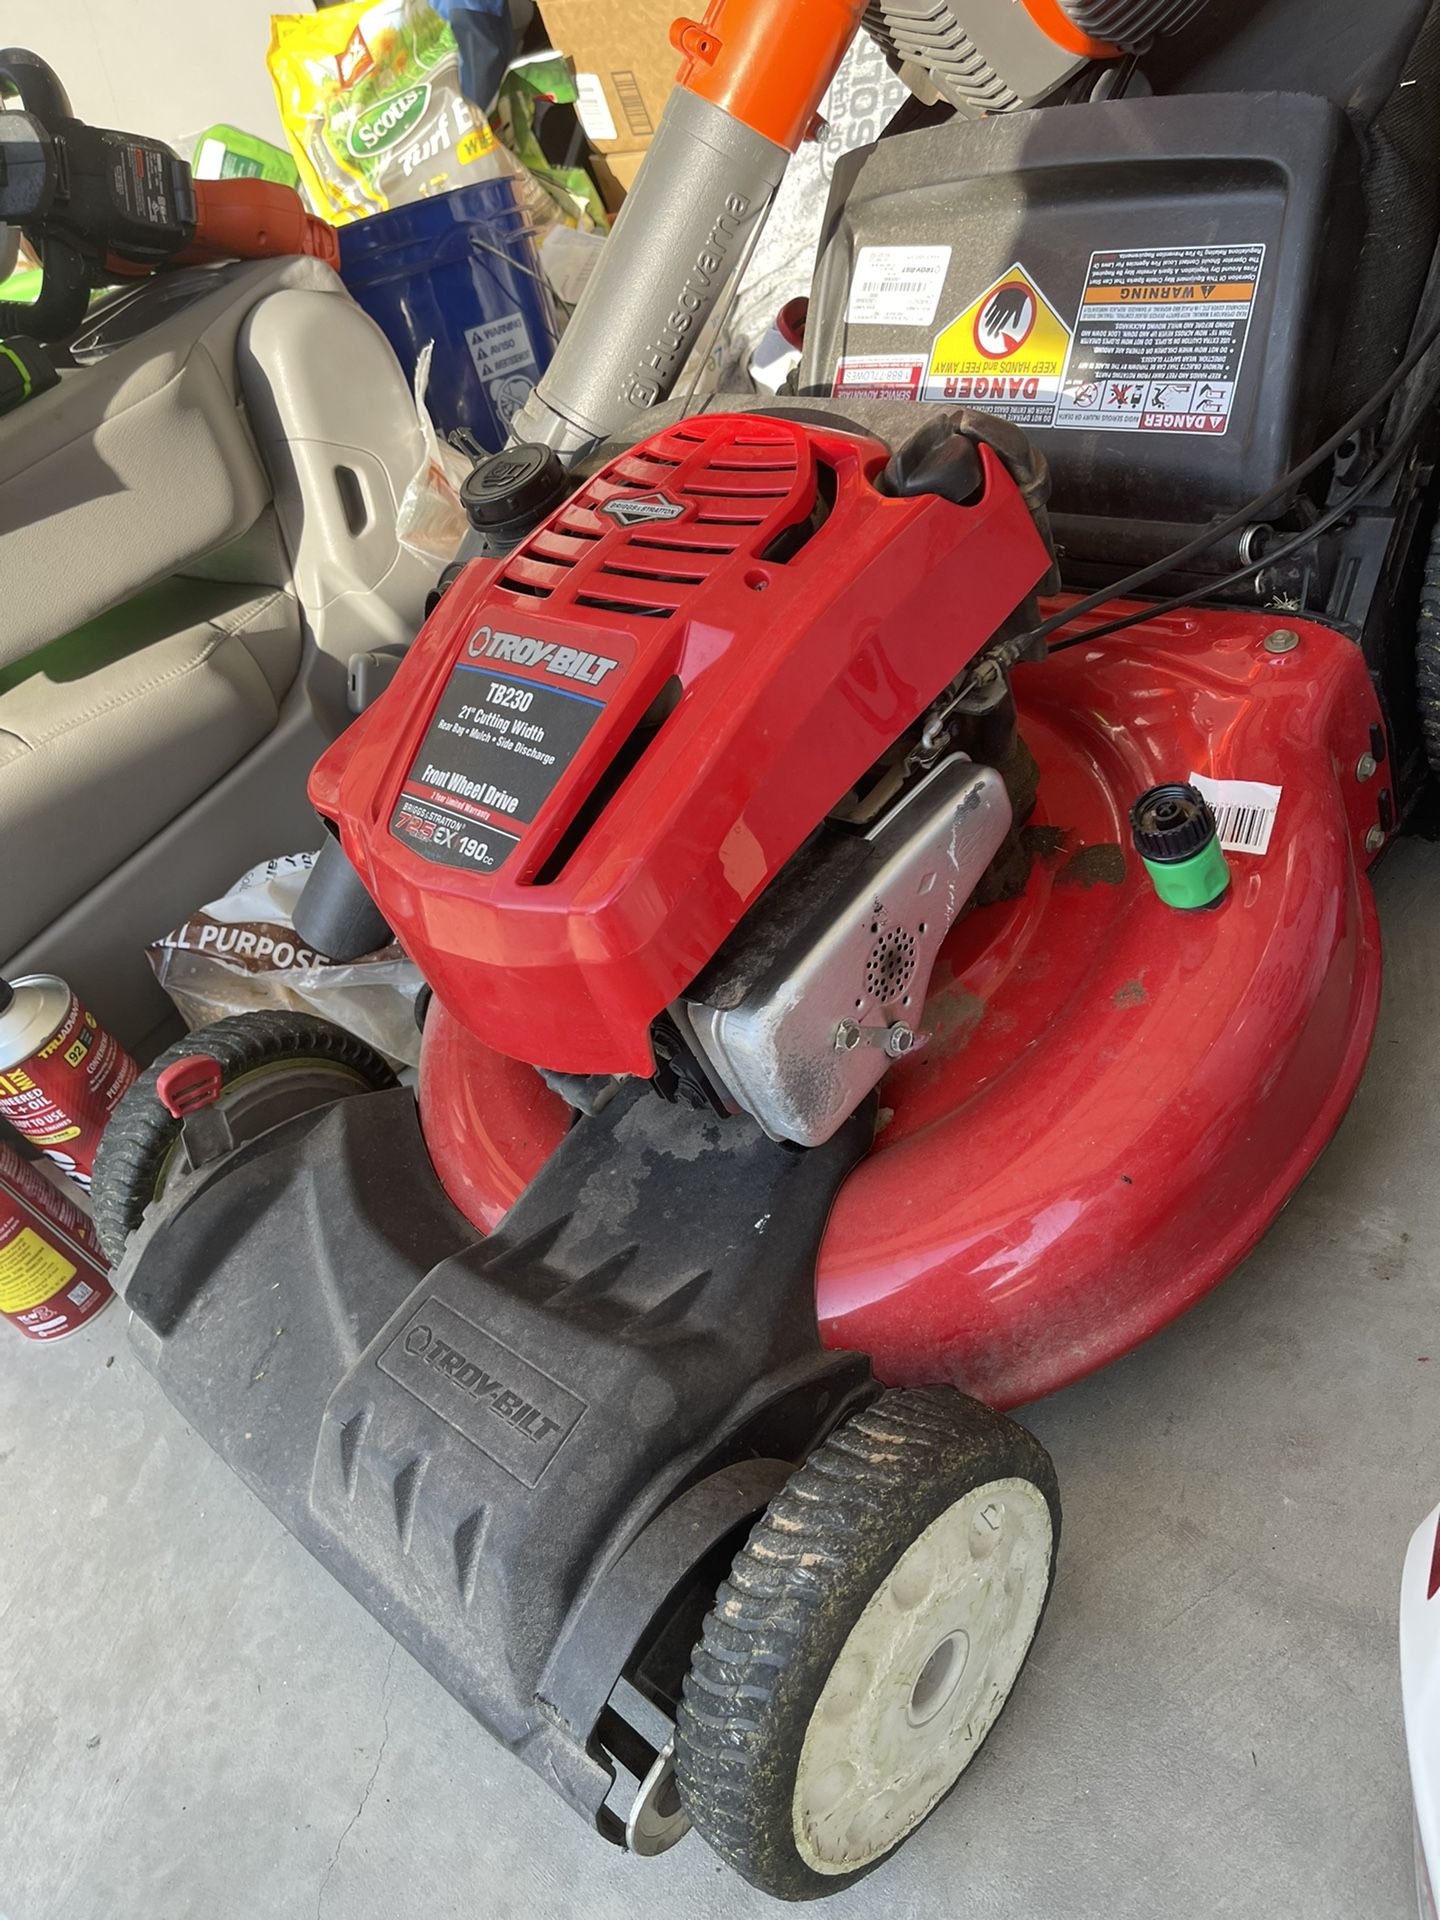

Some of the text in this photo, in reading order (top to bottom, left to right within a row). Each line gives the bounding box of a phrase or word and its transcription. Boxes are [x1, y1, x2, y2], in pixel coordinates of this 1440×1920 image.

[359, 89, 419, 149] Scotts
[398, 113, 452, 176] Turf
[640, 191, 750, 376] Husqvarna
[1226, 273, 1256, 281] Operation
[1118, 286, 1195, 299] WARNING
[483, 319, 522, 340] WARNING
[490, 338, 516, 355] AVISO
[933, 361, 959, 372] AWAY
[959, 361, 981, 372] FEET
[982, 361, 998, 372] and
[999, 360, 1031, 372] HANDS
[1031, 360, 1057, 372] KEEP
[836, 390, 911, 400] SERVICE ADVANTAGE
[942, 377, 1039, 402] DANGER
[1030, 414, 1043, 422] NOT
[1143, 413, 1206, 427] DANGER
[485, 633, 618, 685] TROY-BILT
[486, 682, 534, 712] TB230
[458, 705, 545, 743] 21" Cutting Width
[438, 719, 555, 766] Rear Bag Mulch Side Discharge
[421, 765, 519, 814] Front Wheel Drive
[446, 796, 464, 811] Limited
[463, 801, 491, 820] Warranty
[395, 811, 437, 839] 725
[69, 1045, 84, 1064] 92
[6, 1067, 37, 1091] MIX
[28, 1096, 53, 1110] OIL
[29, 1109, 67, 1128] TO USE
[423, 1339, 561, 1444] TROY-BILT
